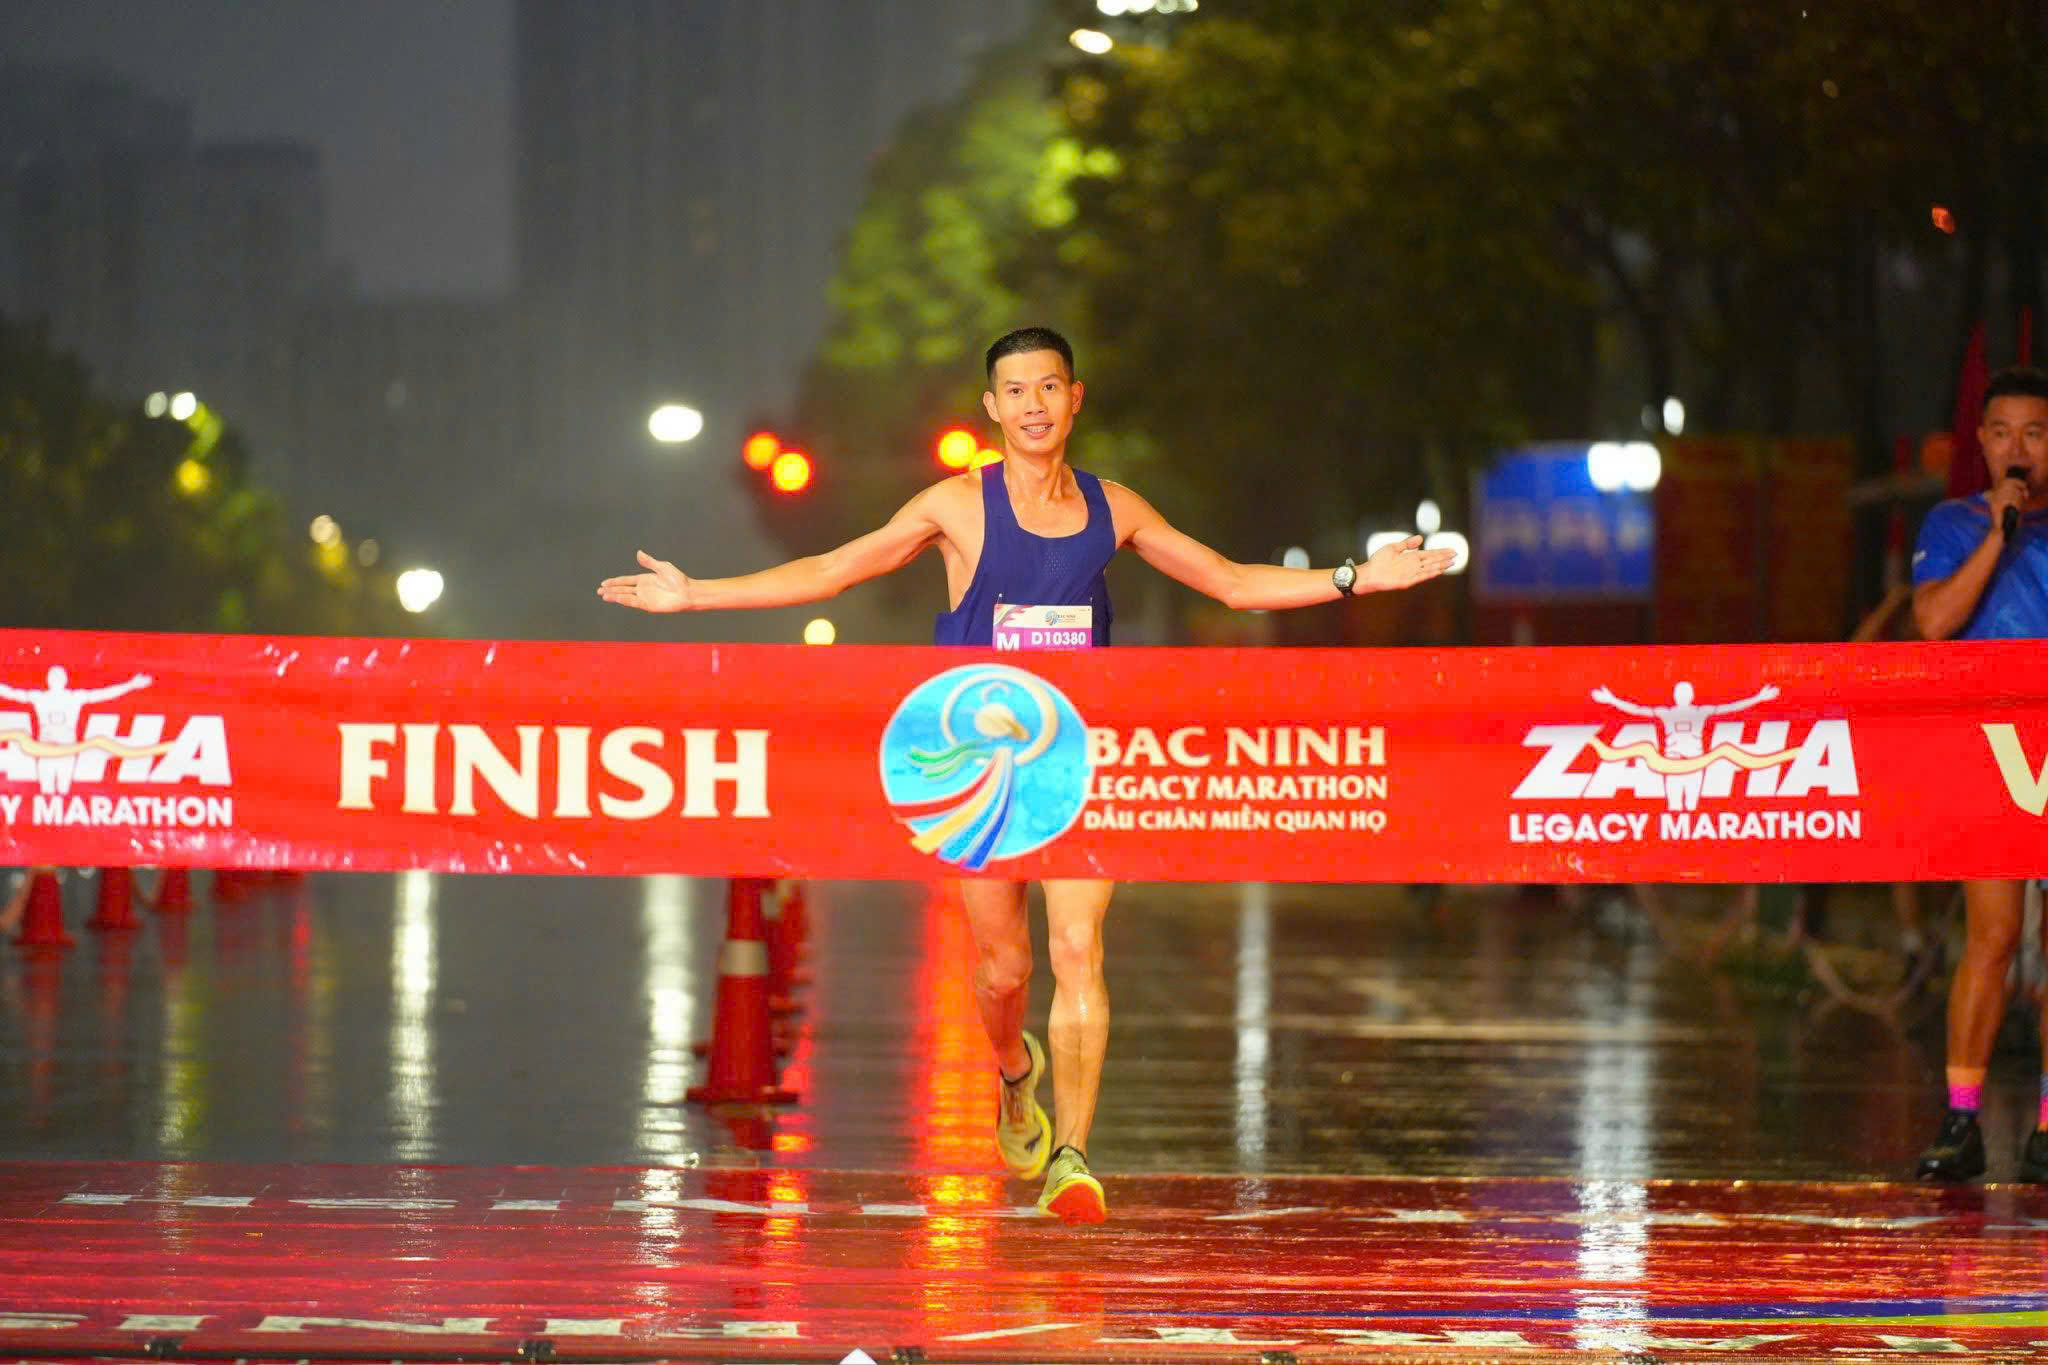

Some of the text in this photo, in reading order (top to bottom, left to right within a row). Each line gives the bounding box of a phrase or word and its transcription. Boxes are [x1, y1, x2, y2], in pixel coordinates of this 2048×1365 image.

[996, 631, 1087, 651] M D10380
[1086, 727, 1387, 767] BAC NINH
[1510, 719, 1860, 799] ZAHA
[338, 723, 770, 820] FINISH
[1084, 775, 1387, 801] LEGACY MARATHON
[32, 795, 233, 827] MARATHON
[1275, 810, 1345, 833] QUAN
[1351, 810, 1387, 834] HỌ
[1510, 810, 1861, 843] LEGACY MARATHON
